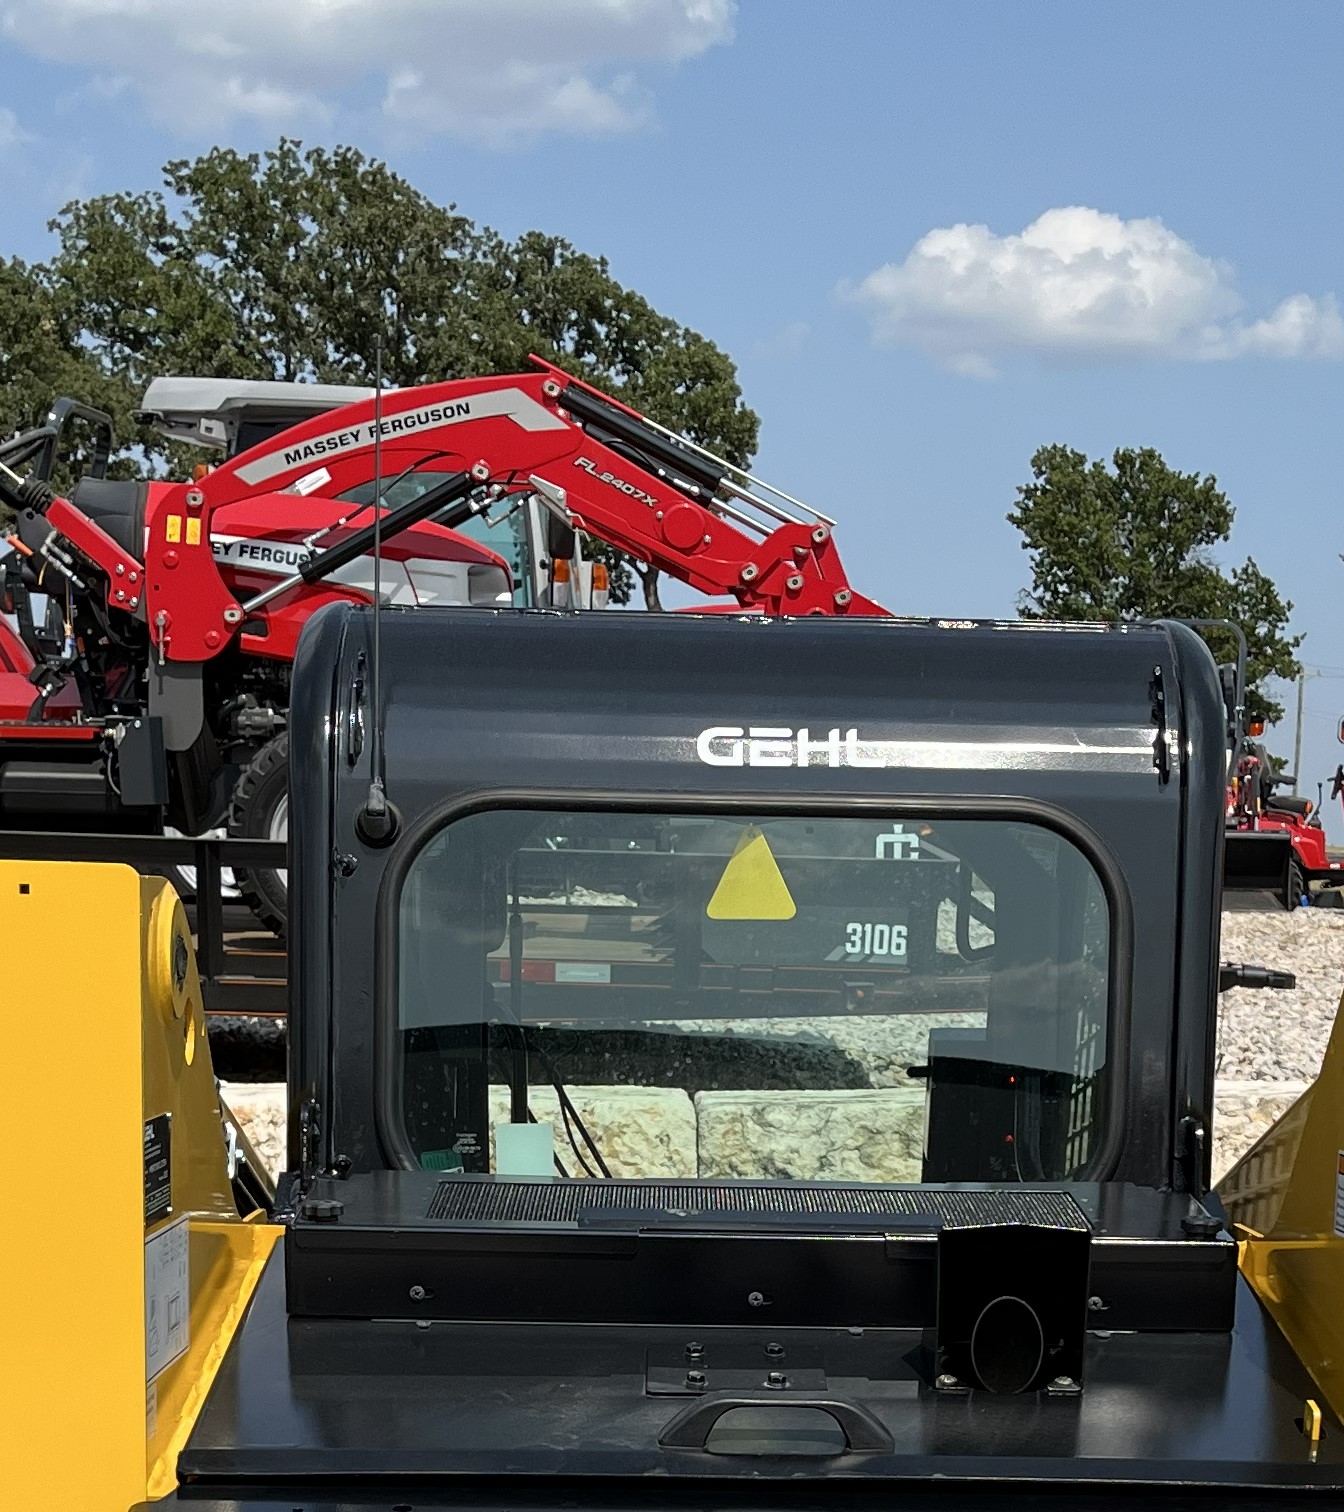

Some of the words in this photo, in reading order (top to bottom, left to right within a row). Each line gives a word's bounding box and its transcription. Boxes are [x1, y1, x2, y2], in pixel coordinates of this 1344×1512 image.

[284, 426, 361, 464] MASSEY
[368, 402, 470, 438] FERGUSON
[573, 456, 659, 507] FL.2407X
[696, 726, 886, 768] GEHL
[845, 922, 908, 956] 3106
